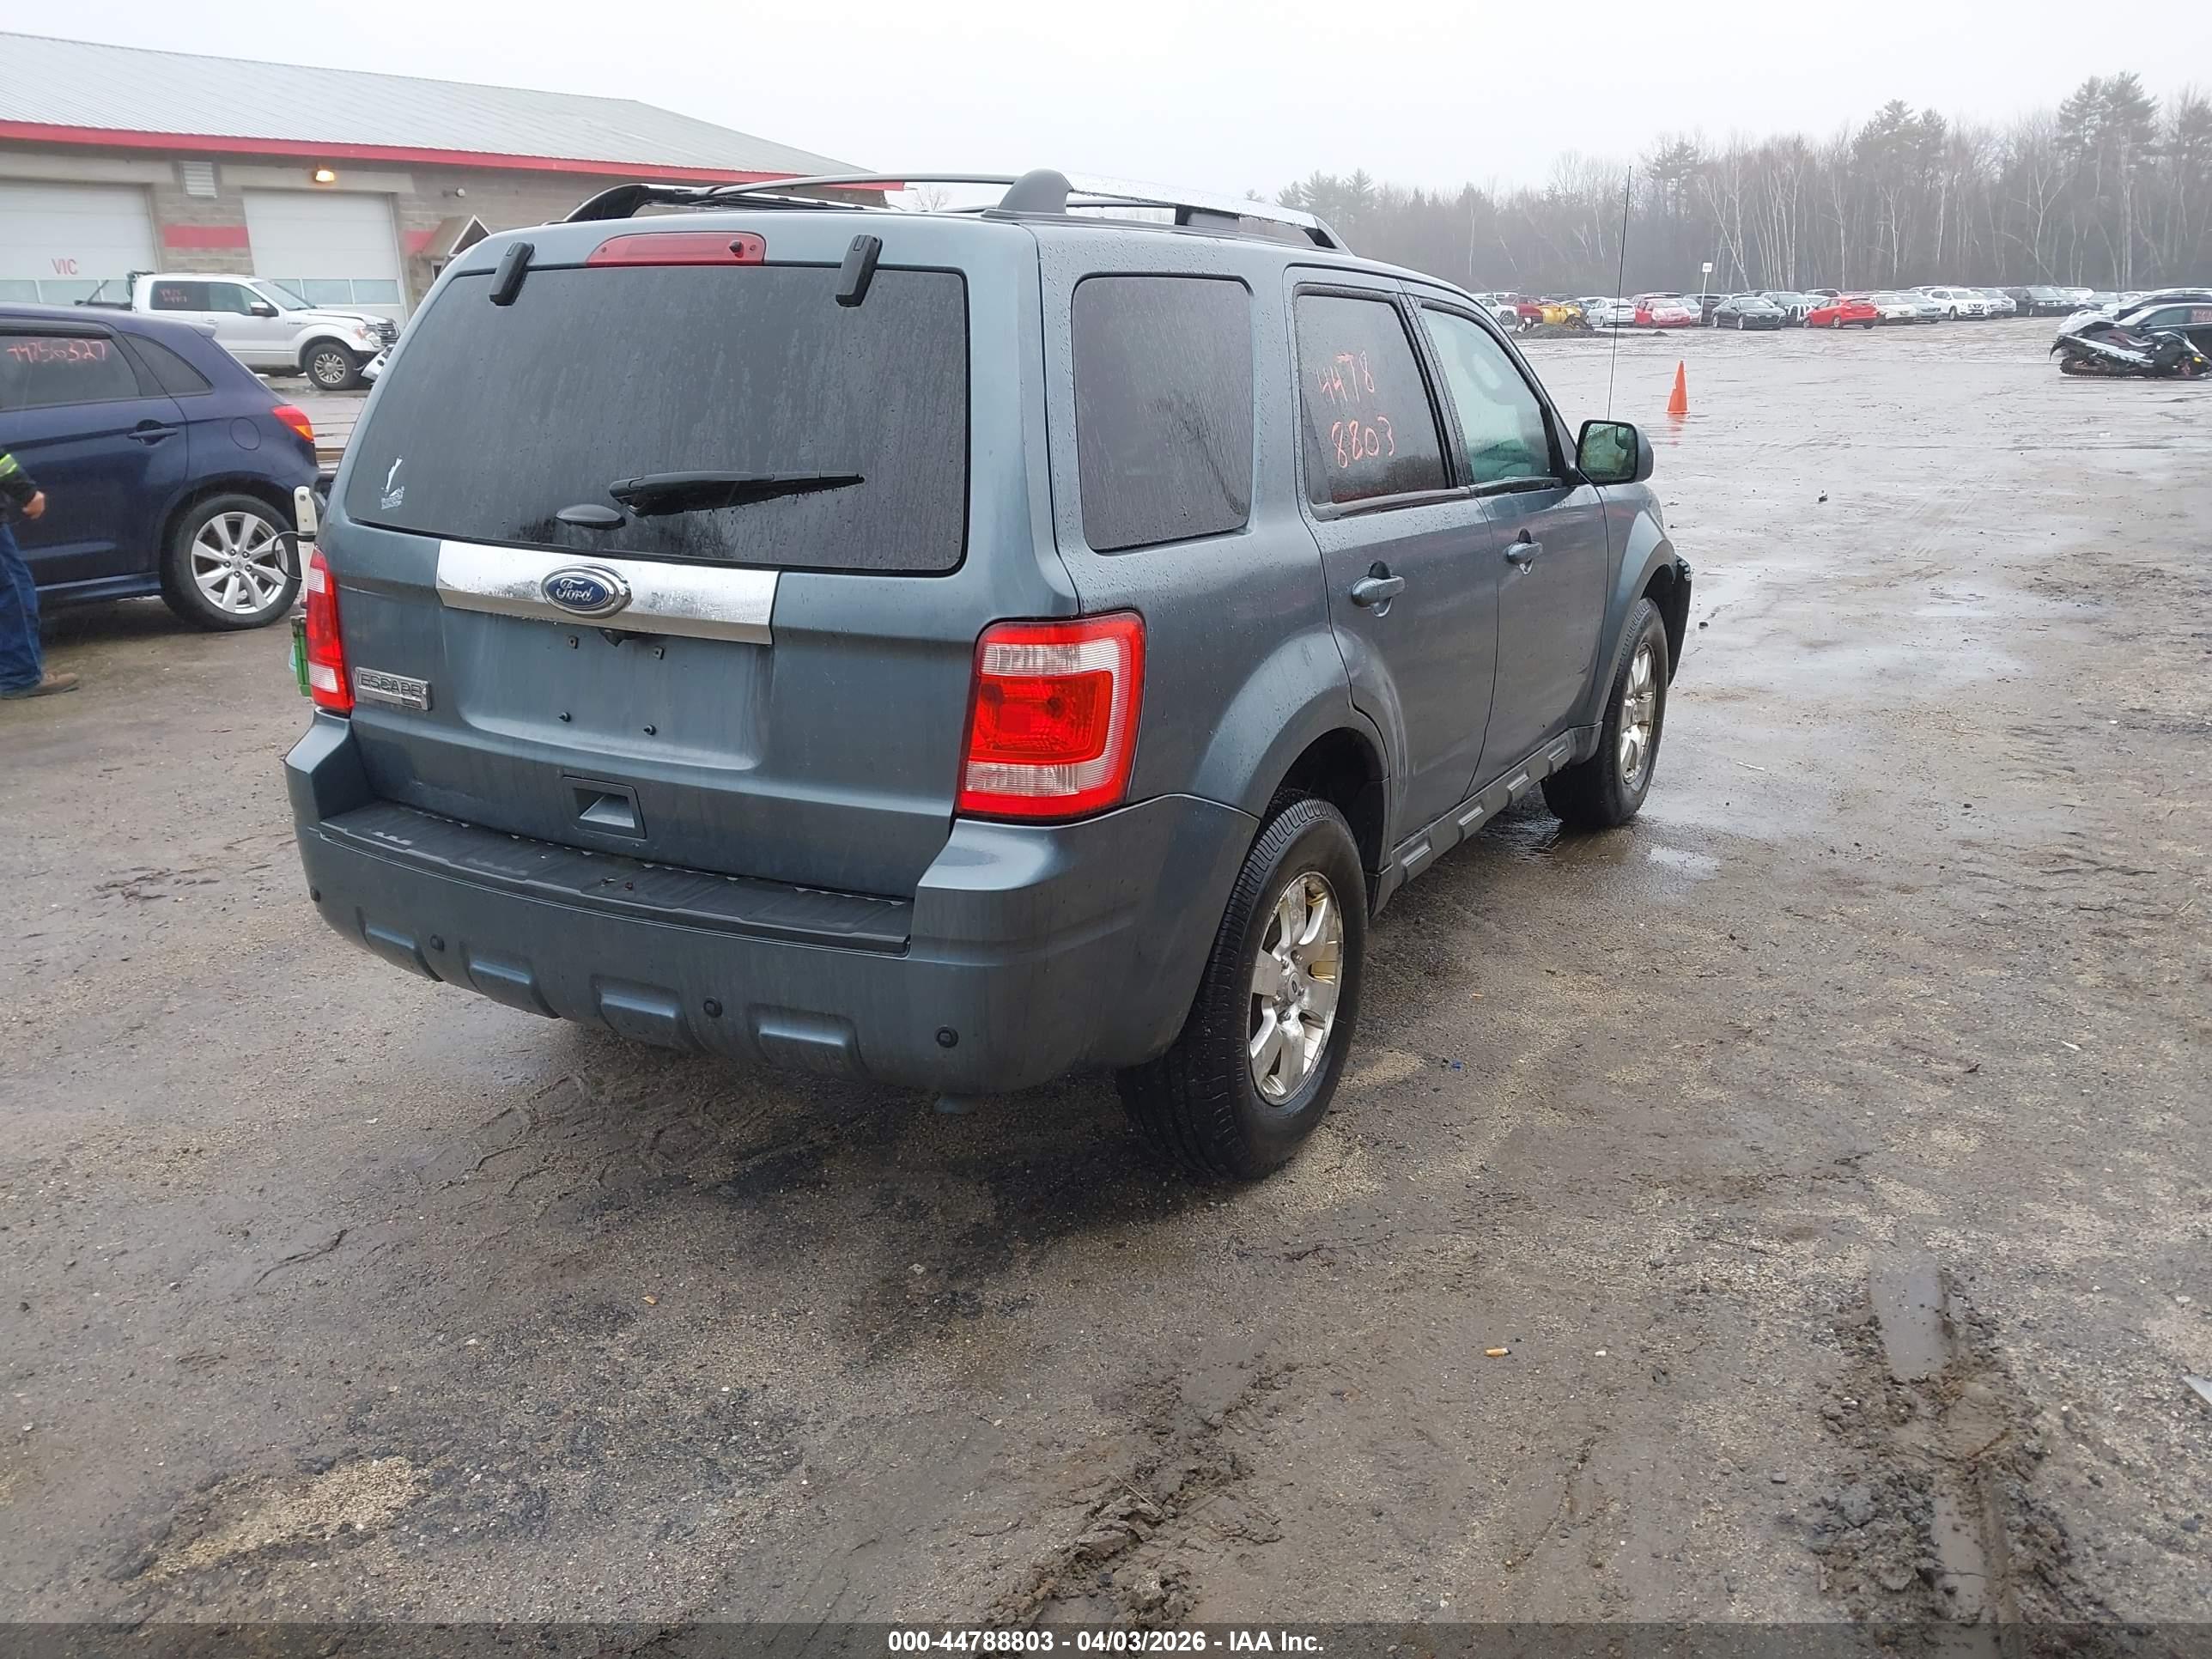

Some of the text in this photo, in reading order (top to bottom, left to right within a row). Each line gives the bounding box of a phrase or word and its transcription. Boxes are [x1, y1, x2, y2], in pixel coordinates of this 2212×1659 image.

[51, 258, 78, 275] VIC
[1316, 349, 1375, 405] 4478
[1331, 415, 1395, 469] 8803
[556, 577, 594, 602] Ford
[360, 672, 422, 697] ESCAPE
